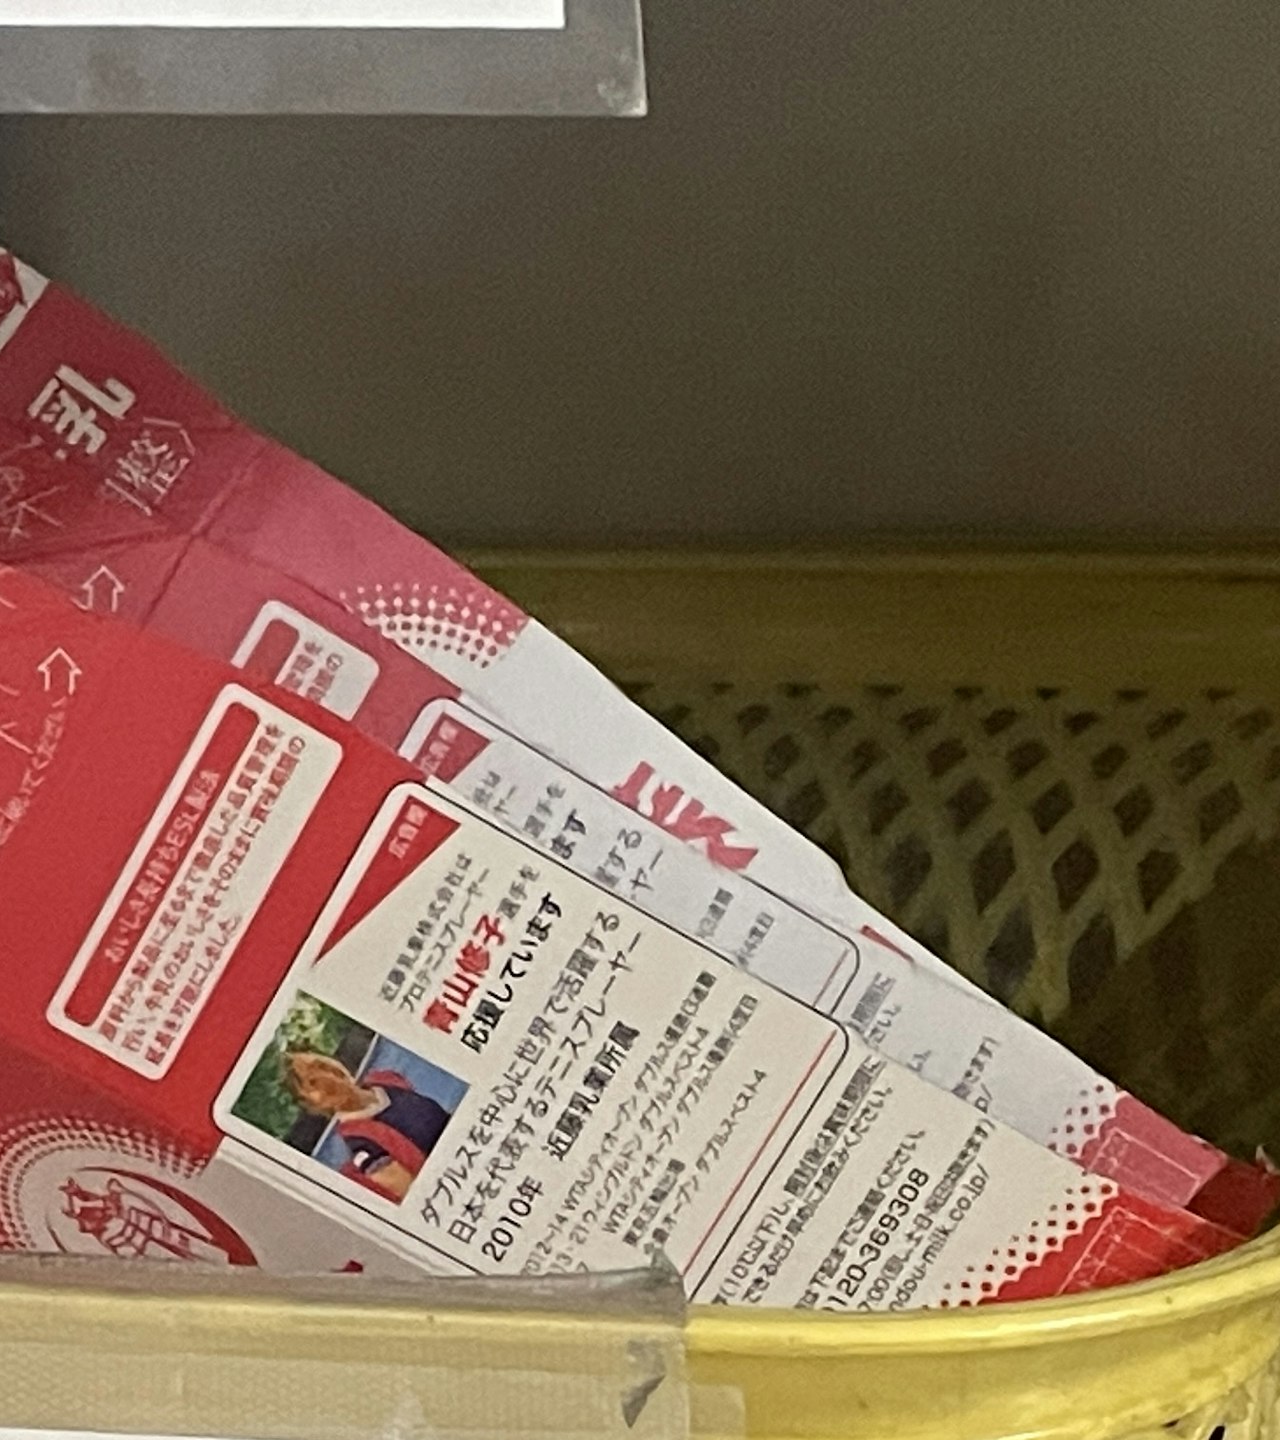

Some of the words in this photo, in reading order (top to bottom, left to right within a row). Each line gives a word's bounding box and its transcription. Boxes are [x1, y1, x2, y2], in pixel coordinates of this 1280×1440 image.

[413, 905, 624, 1229] ダブルスを中心に世界で活躍する
[445, 926, 655, 1246] 日本を代表するテニスプレーヤー
[458, 891, 568, 1054] 応援しています
[478, 1172, 548, 1264] 2010年
[539, 1017, 642, 1163] 近藤乳業所属
[822, 1163, 932, 1320] 120-369308
